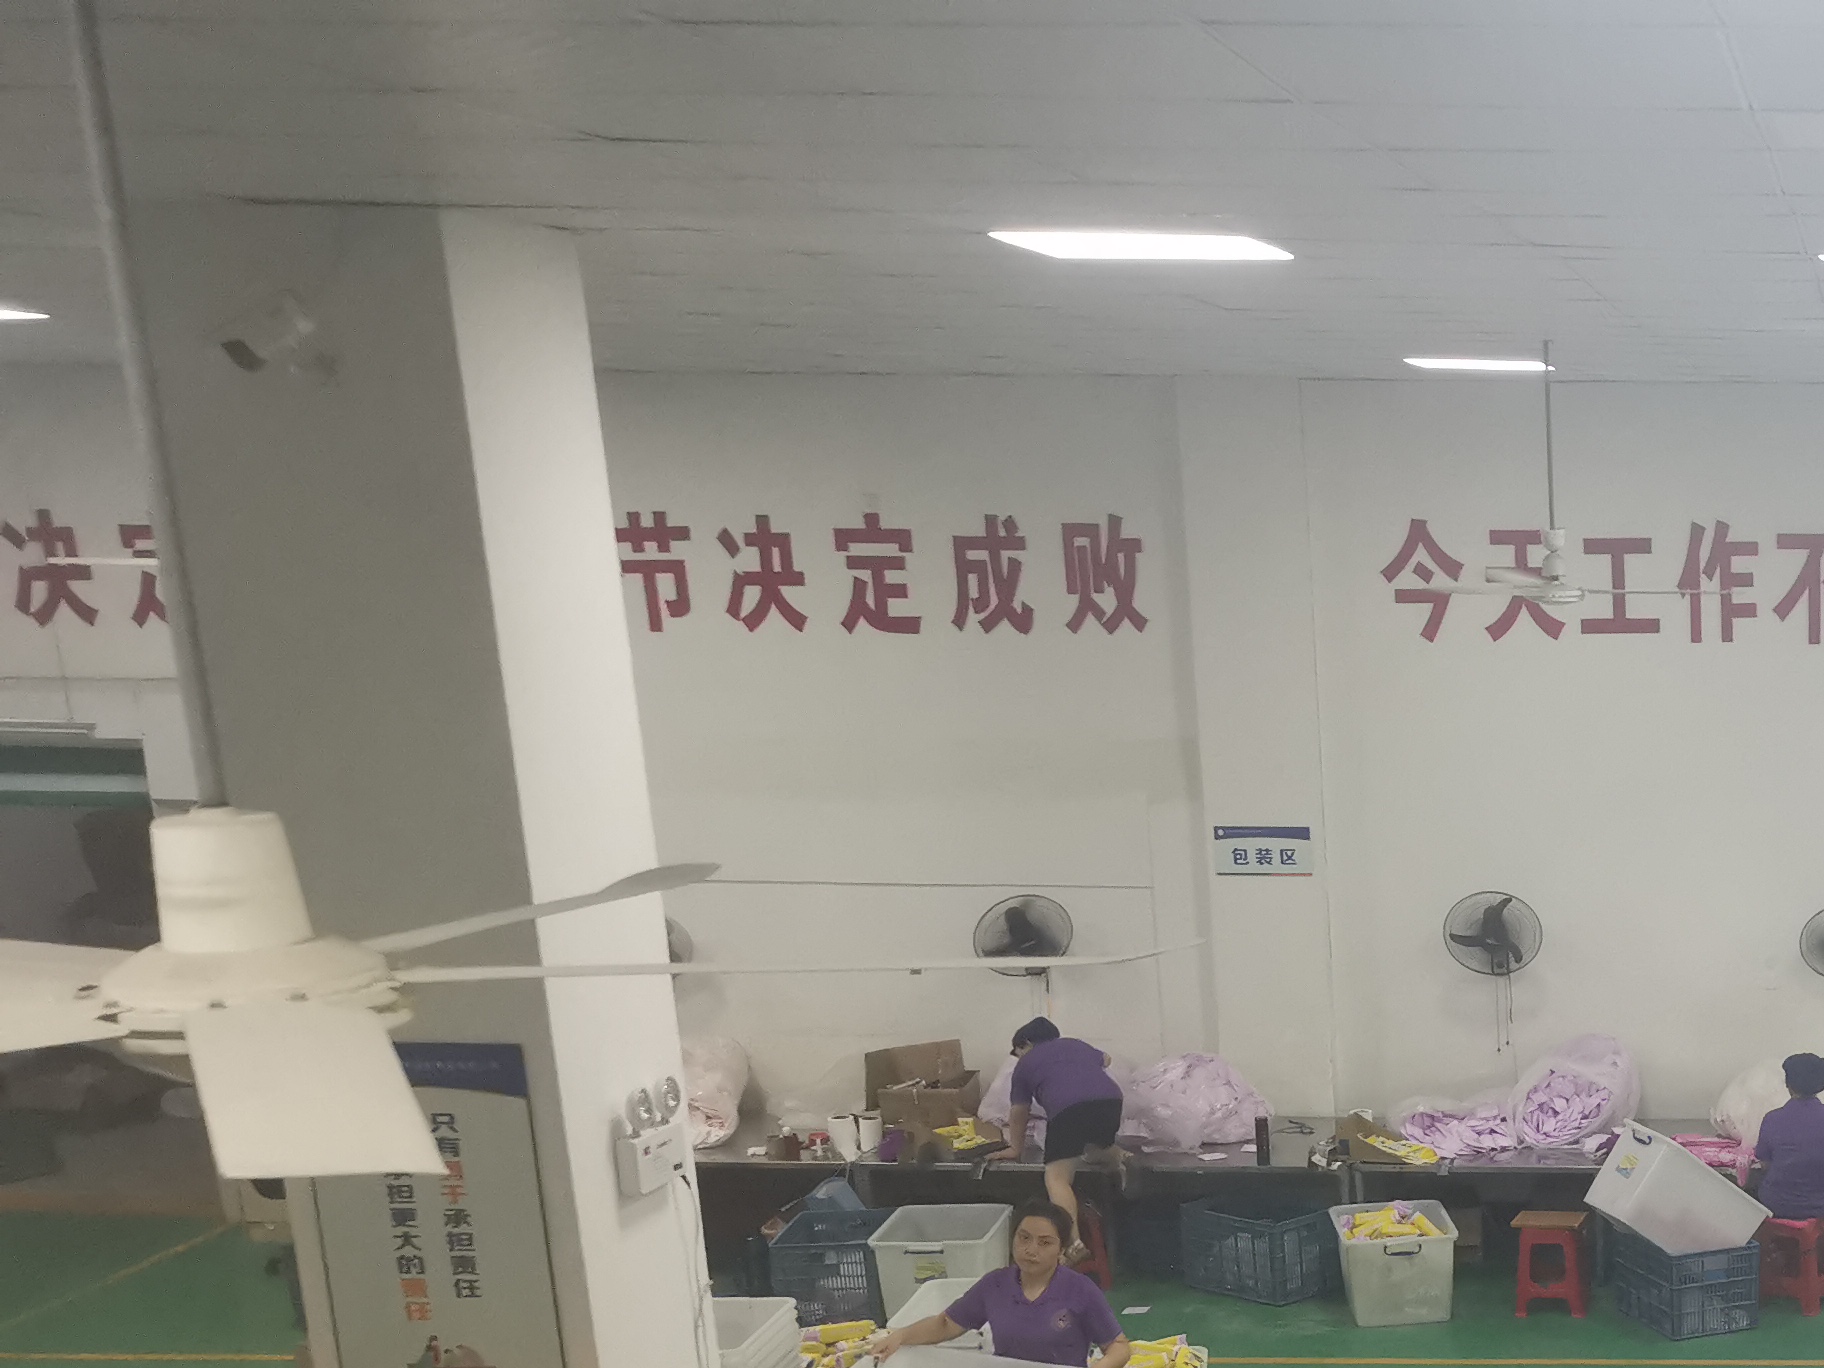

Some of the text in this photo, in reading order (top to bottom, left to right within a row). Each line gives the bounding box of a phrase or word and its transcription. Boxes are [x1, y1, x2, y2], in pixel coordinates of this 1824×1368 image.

[615, 511, 1149, 635] 节决定成败
[1231, 847, 1297, 865] 包装区
